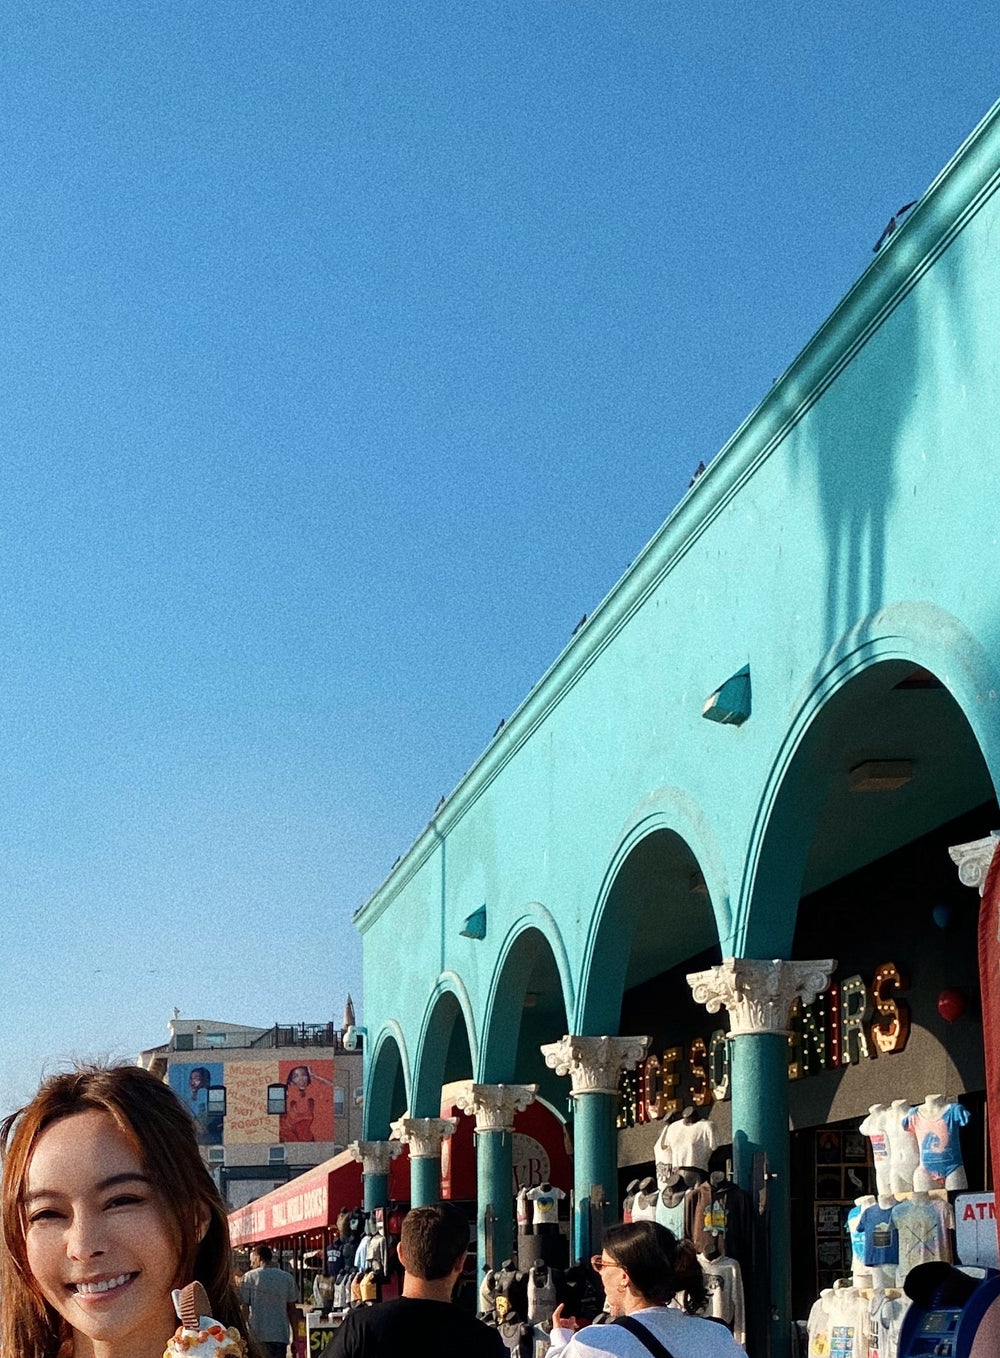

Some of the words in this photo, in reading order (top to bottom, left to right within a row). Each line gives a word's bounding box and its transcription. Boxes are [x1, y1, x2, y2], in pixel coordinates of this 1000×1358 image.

[616, 1046, 682, 1128] NICE
[690, 962, 908, 1106] SONIRS
[229, 1066, 261, 1076] MUSIC
[234, 1106, 254, 1117] NOT
[230, 1118, 271, 1130] ROBOTS
[310, 1331, 334, 1351] SM
